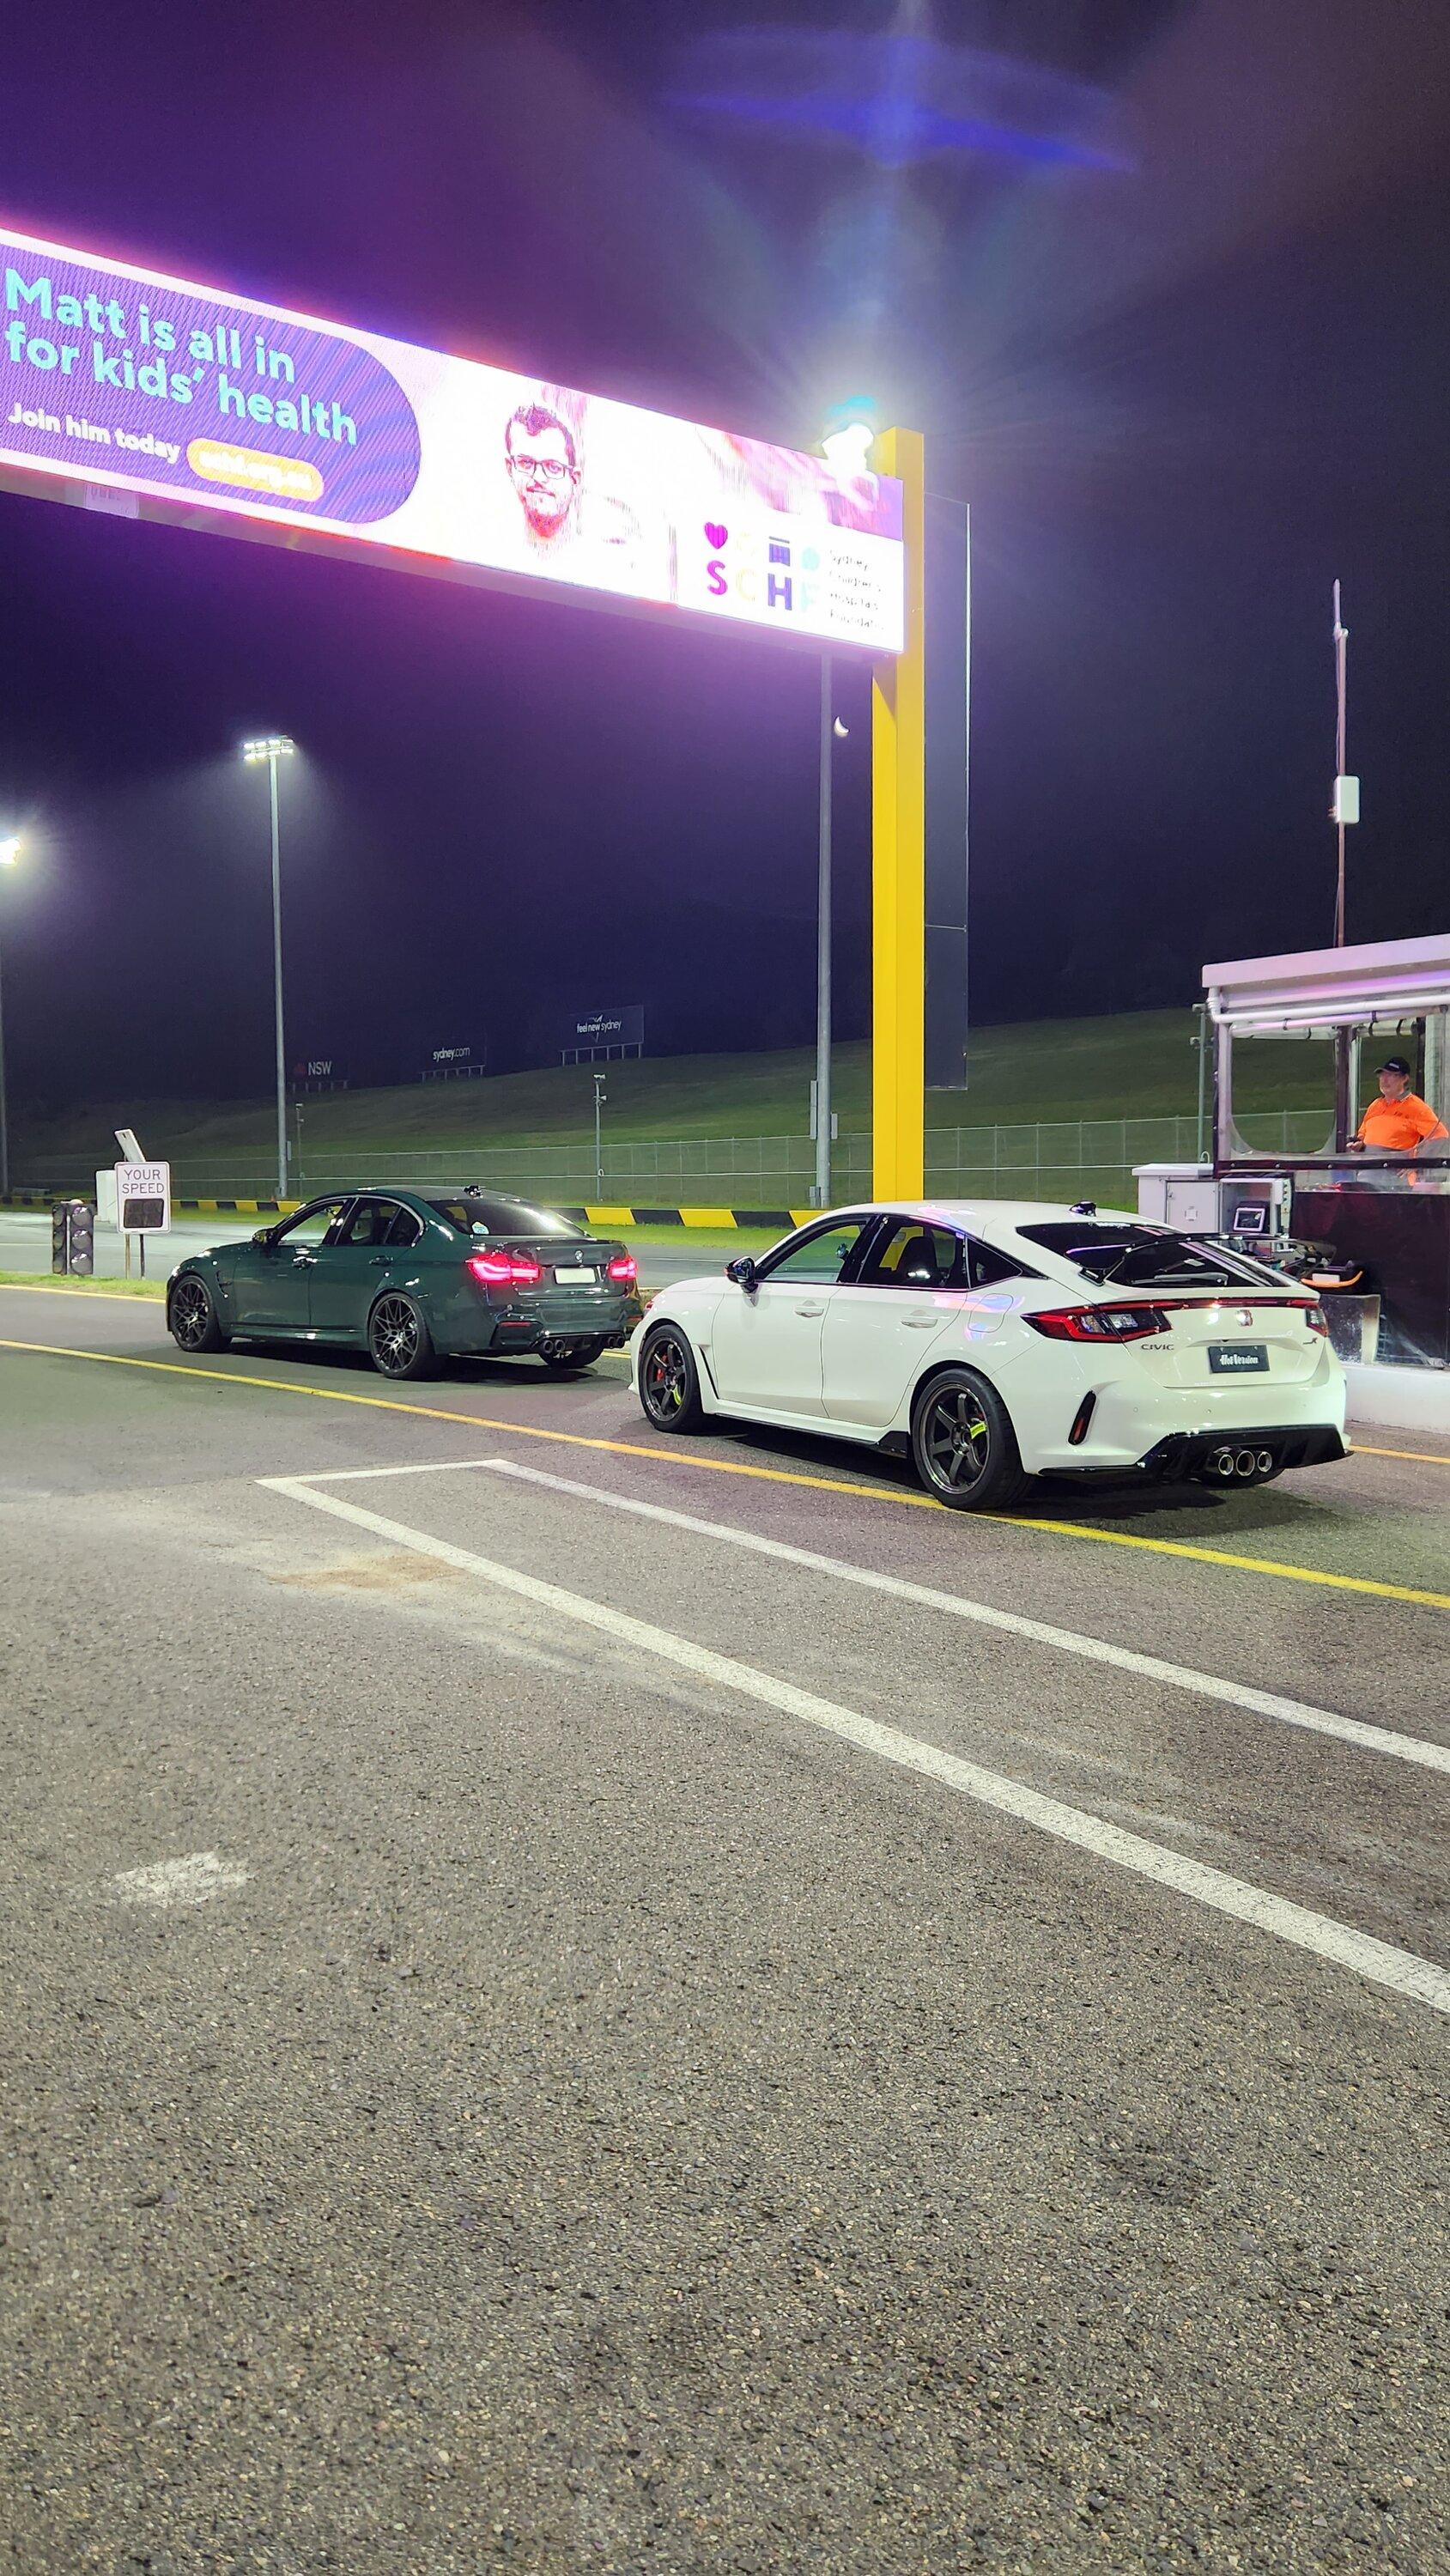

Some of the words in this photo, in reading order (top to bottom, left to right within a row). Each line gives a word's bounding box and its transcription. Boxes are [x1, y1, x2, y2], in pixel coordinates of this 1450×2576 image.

[6, 268, 127, 338] Matt
[138, 303, 176, 351] is
[188, 325, 241, 368] all
[255, 335, 294, 383] in
[5, 320, 80, 374] for
[218, 374, 356, 446] health
[8, 402, 61, 434] Join
[65, 414, 111, 445] him
[114, 428, 180, 465] today
[601, 1019, 622, 1033] sydney
[433, 1048, 470, 1062] sydney.com
[308, 1060, 332, 1076] NSW
[124, 1169, 161, 1180] YOUR
[122, 1183, 165, 1194] SPEED
